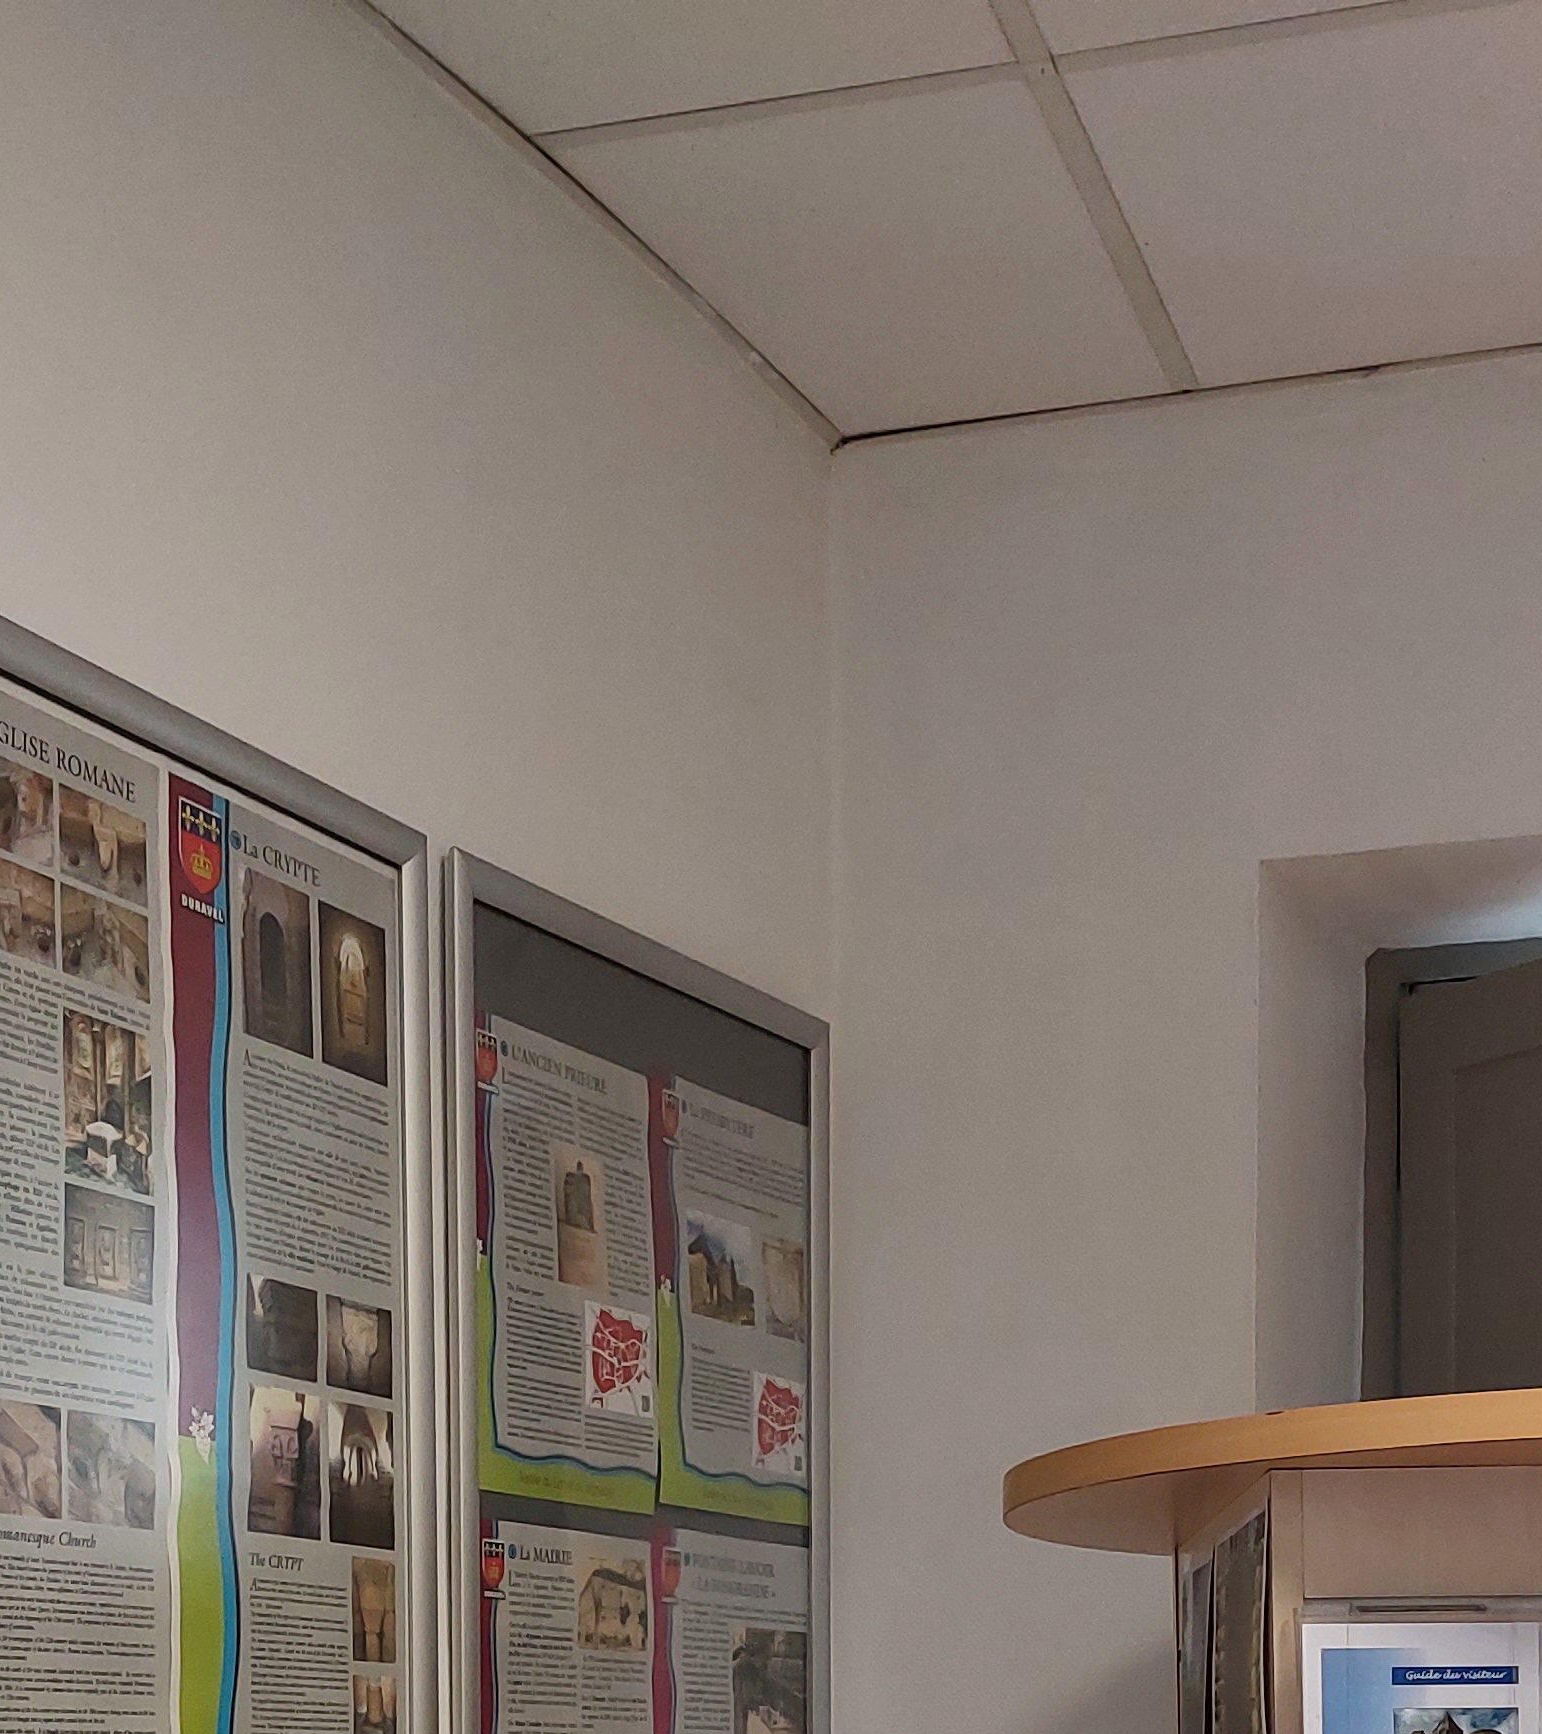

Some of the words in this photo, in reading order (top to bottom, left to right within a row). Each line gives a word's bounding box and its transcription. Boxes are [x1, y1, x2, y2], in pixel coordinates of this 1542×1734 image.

[56, 747, 136, 803] ROMANE
[242, 834, 259, 857] La
[262, 842, 322, 888] CRYPTE
[181, 893, 225, 923] DURAVEL
[59, 1532, 97, 1549] Church
[520, 1545, 530, 1560] La
[533, 1547, 573, 1565] MAIRIE
[1405, 1669, 1441, 1681] Guide
[1443, 1670, 1461, 1680] du
